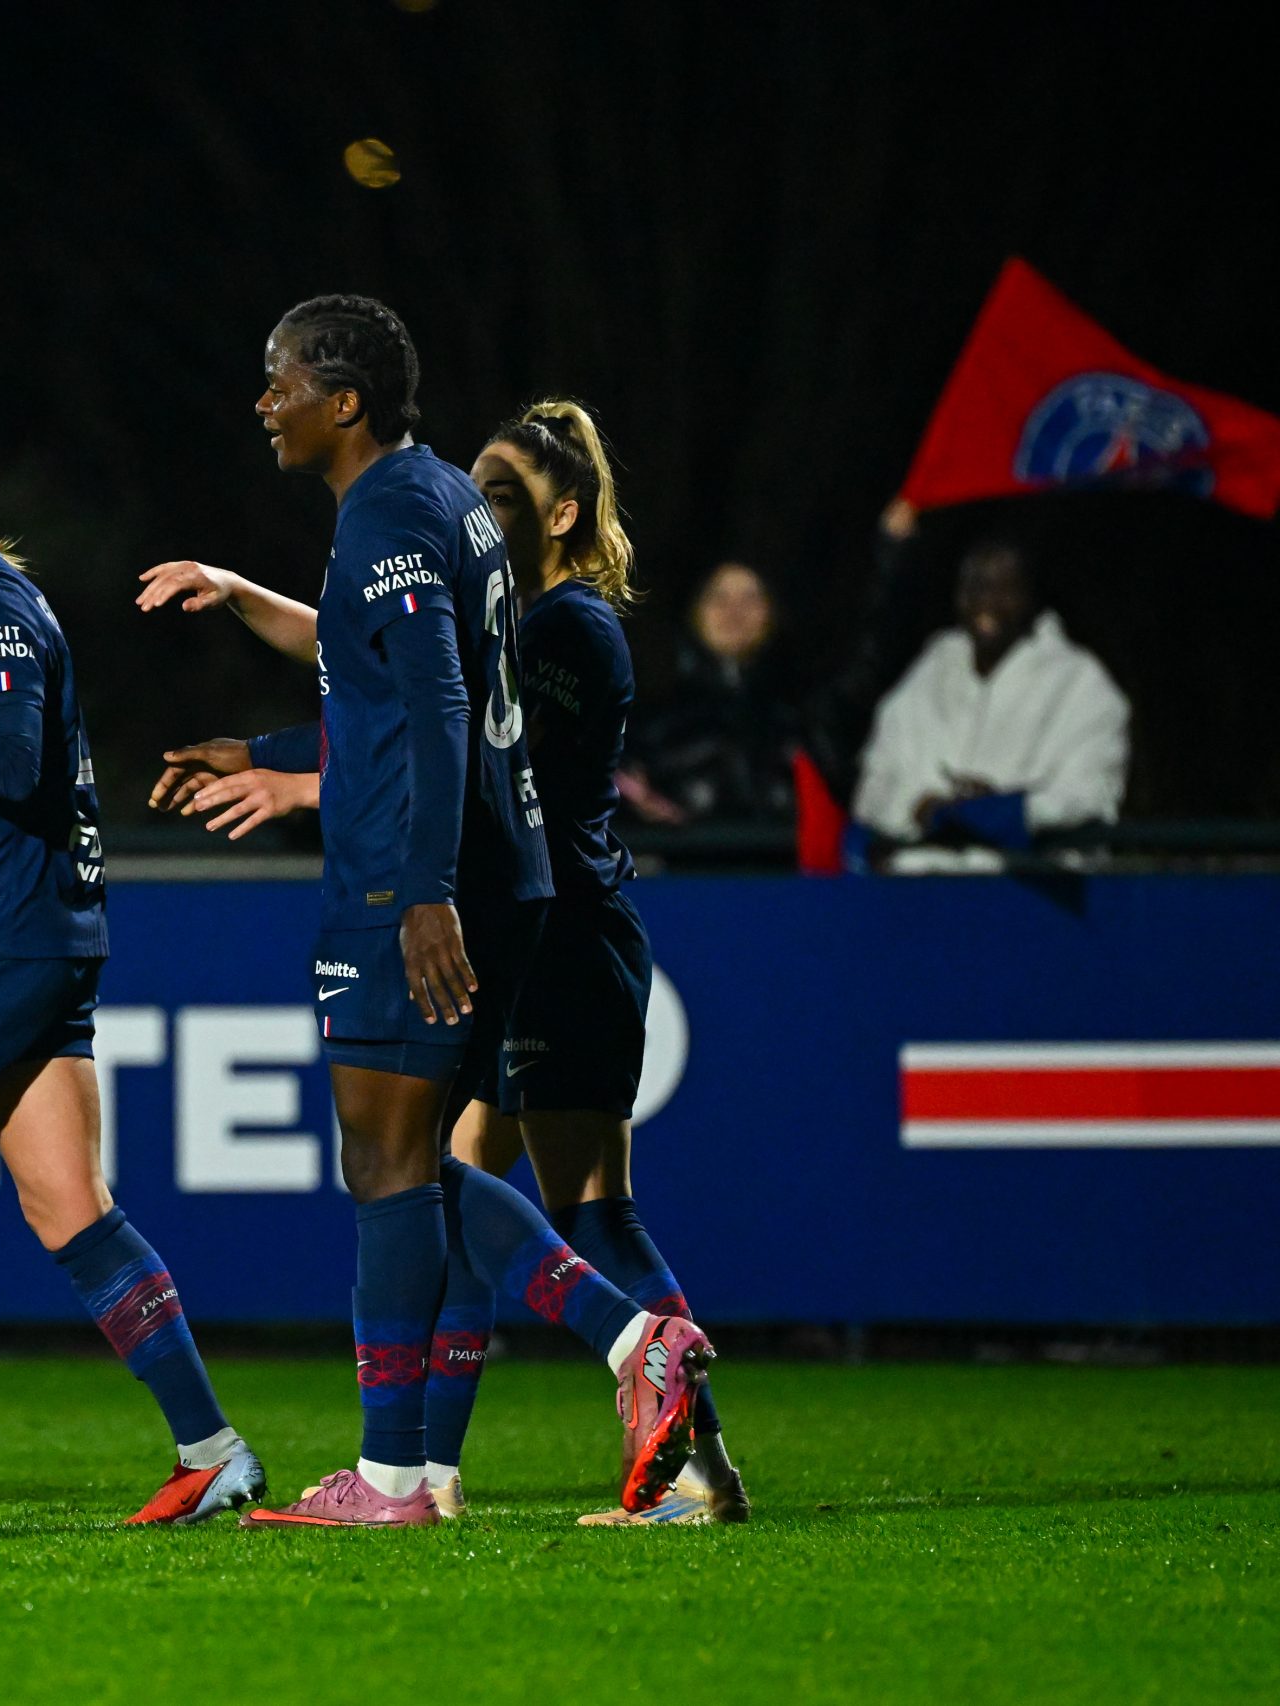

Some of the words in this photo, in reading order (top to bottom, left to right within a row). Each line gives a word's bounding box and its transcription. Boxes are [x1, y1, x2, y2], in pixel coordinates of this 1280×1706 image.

[372, 553, 422, 577] VISIT
[363, 570, 445, 602] RWANDA
[538, 658, 580, 691] VISIT
[521, 672, 581, 717] WANDA
